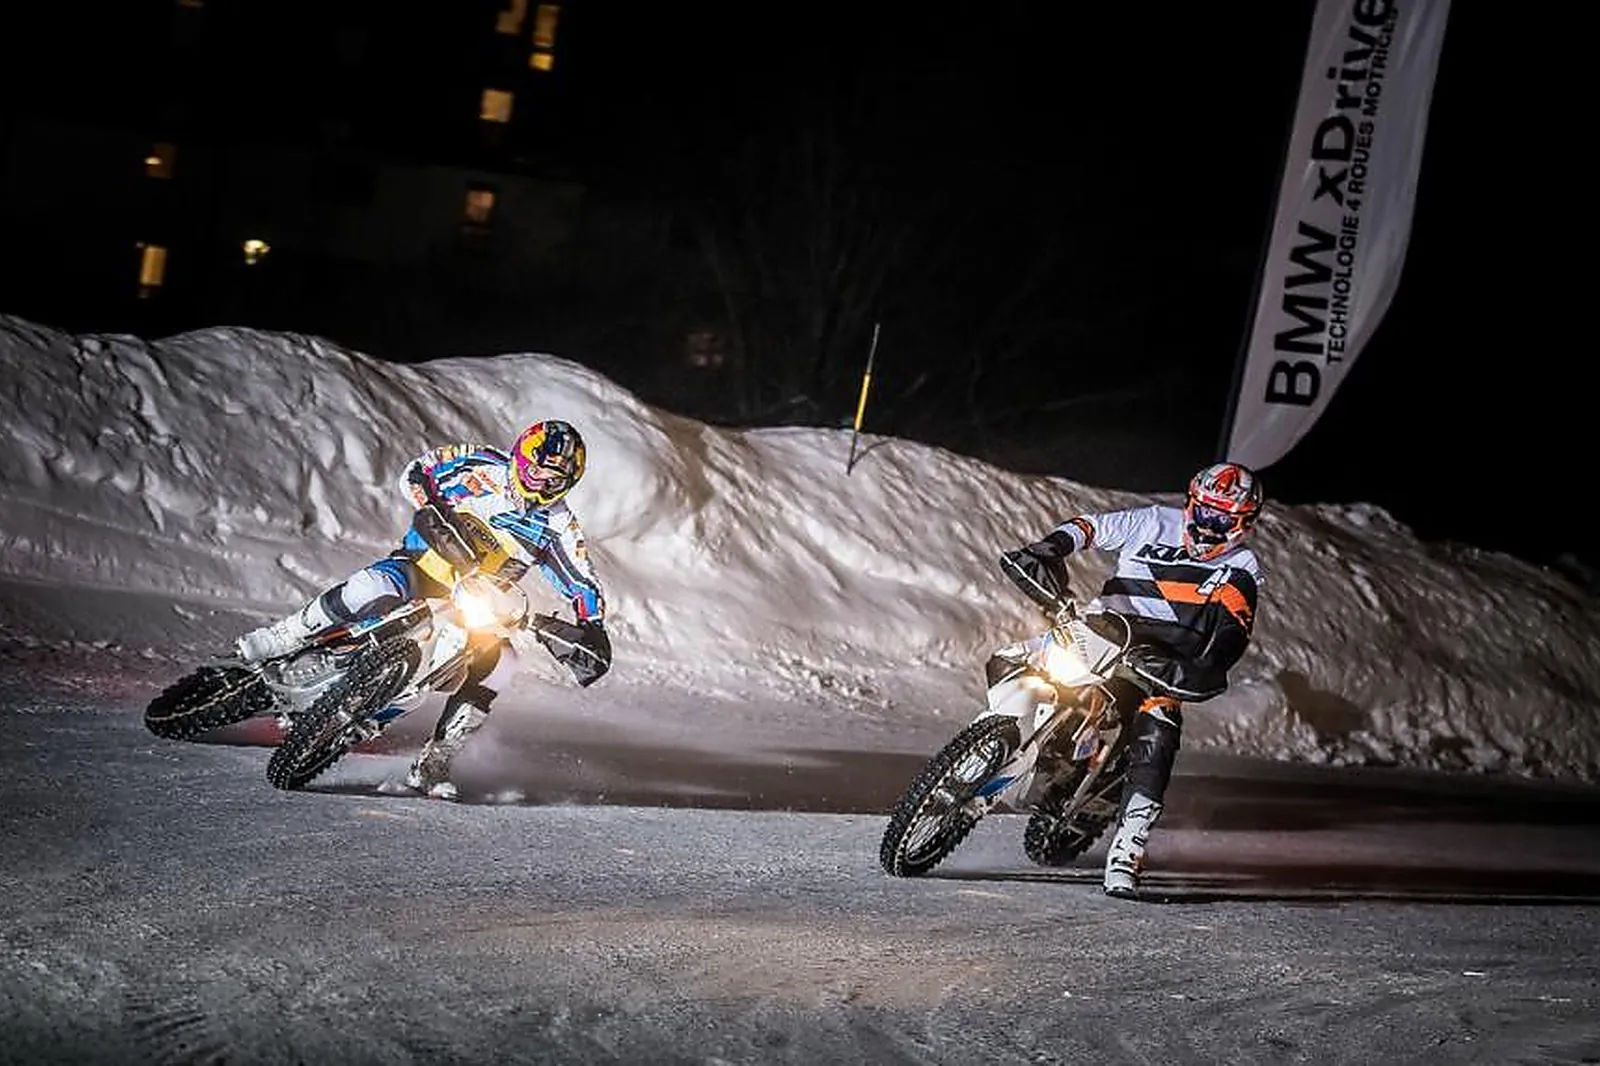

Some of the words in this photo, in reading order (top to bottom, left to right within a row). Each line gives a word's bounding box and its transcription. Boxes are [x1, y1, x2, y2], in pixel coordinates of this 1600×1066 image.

[1264, 221, 1338, 407] BMW
[1311, 0, 1392, 207] xDrive
[1346, 200, 1362, 212] 4
[1347, 121, 1374, 195] ROUES
[1326, 215, 1359, 365] TECHNOLOGIE
